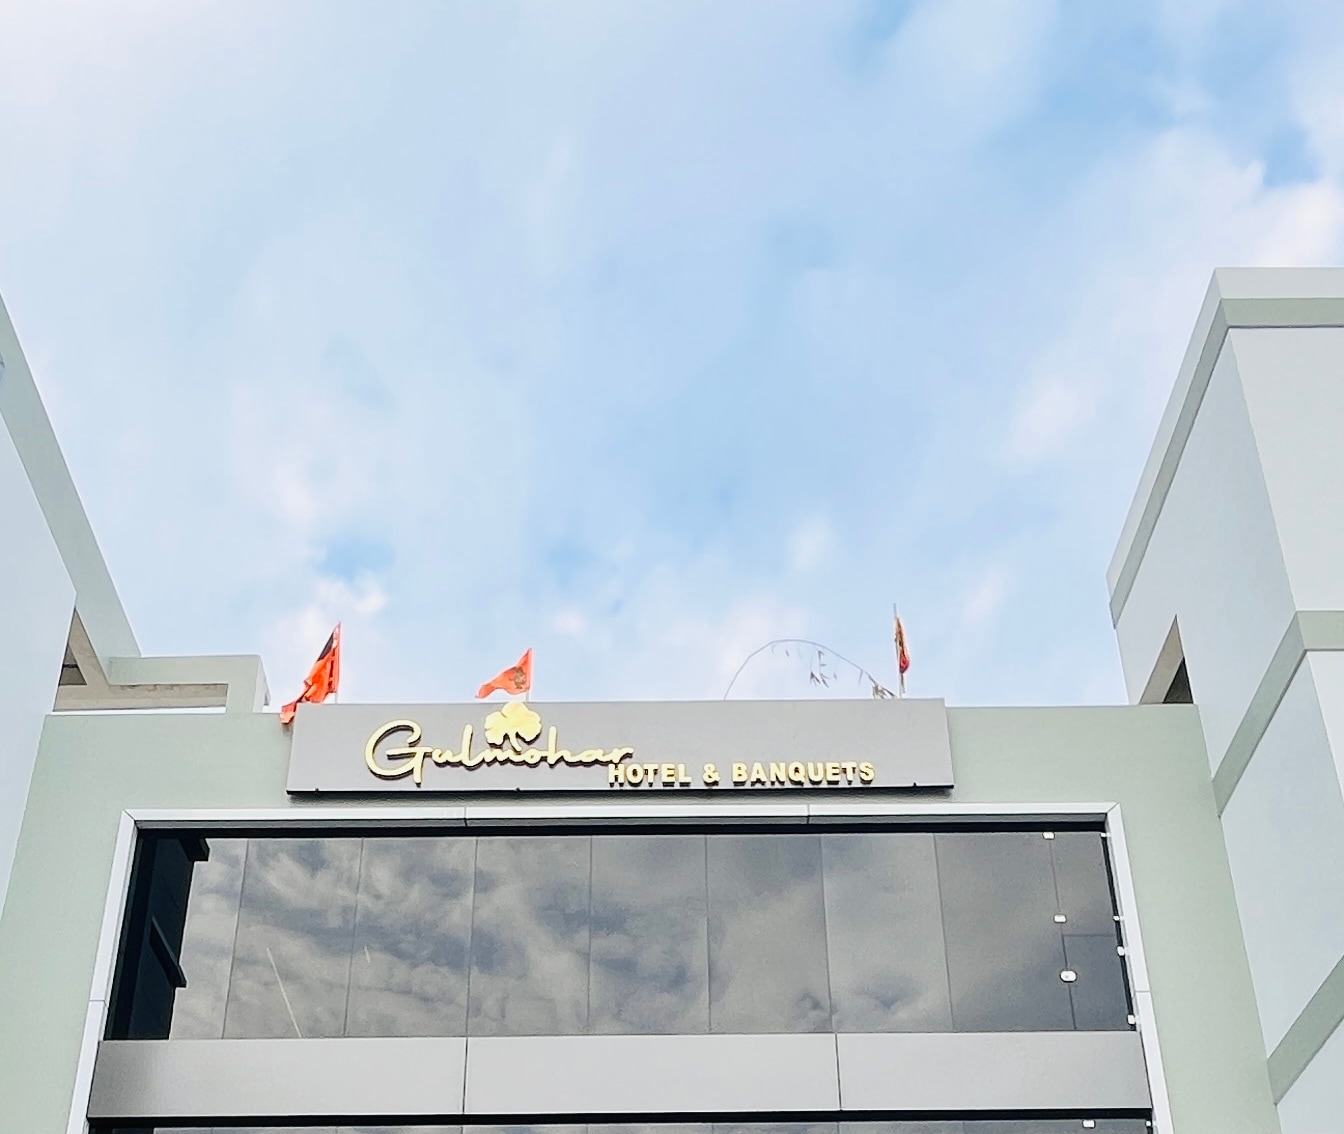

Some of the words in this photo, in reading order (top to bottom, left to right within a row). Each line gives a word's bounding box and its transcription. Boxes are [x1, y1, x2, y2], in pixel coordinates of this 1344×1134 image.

[364, 718, 635, 788] Gulmohar
[608, 762, 693, 787] HOTEL
[702, 763, 722, 786] &
[731, 761, 876, 787] BANQUETS
